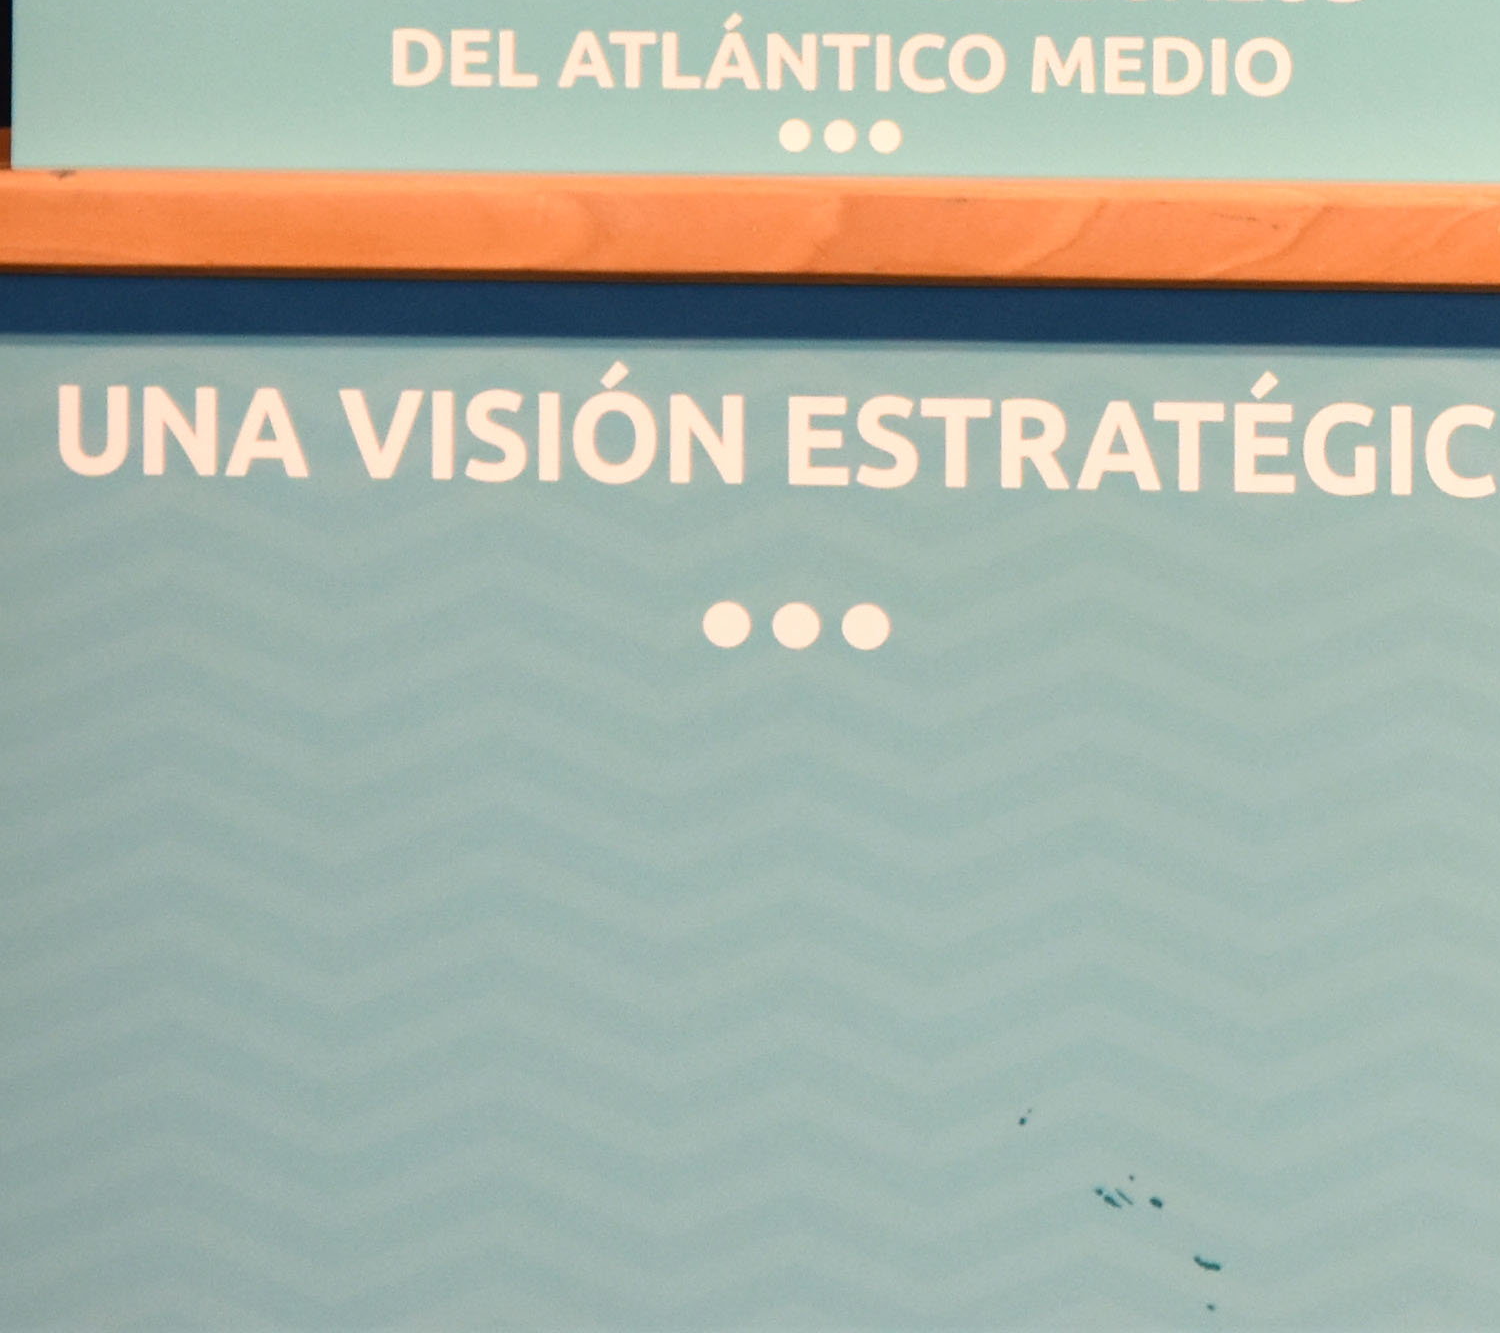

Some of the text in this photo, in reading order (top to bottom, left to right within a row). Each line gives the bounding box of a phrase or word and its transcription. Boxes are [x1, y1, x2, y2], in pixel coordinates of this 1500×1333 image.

[392, 12, 1293, 99] DEL ATLÁNTICO MEDIO
[57, 383, 309, 479] UNA
[339, 360, 746, 486] VISIÓN
